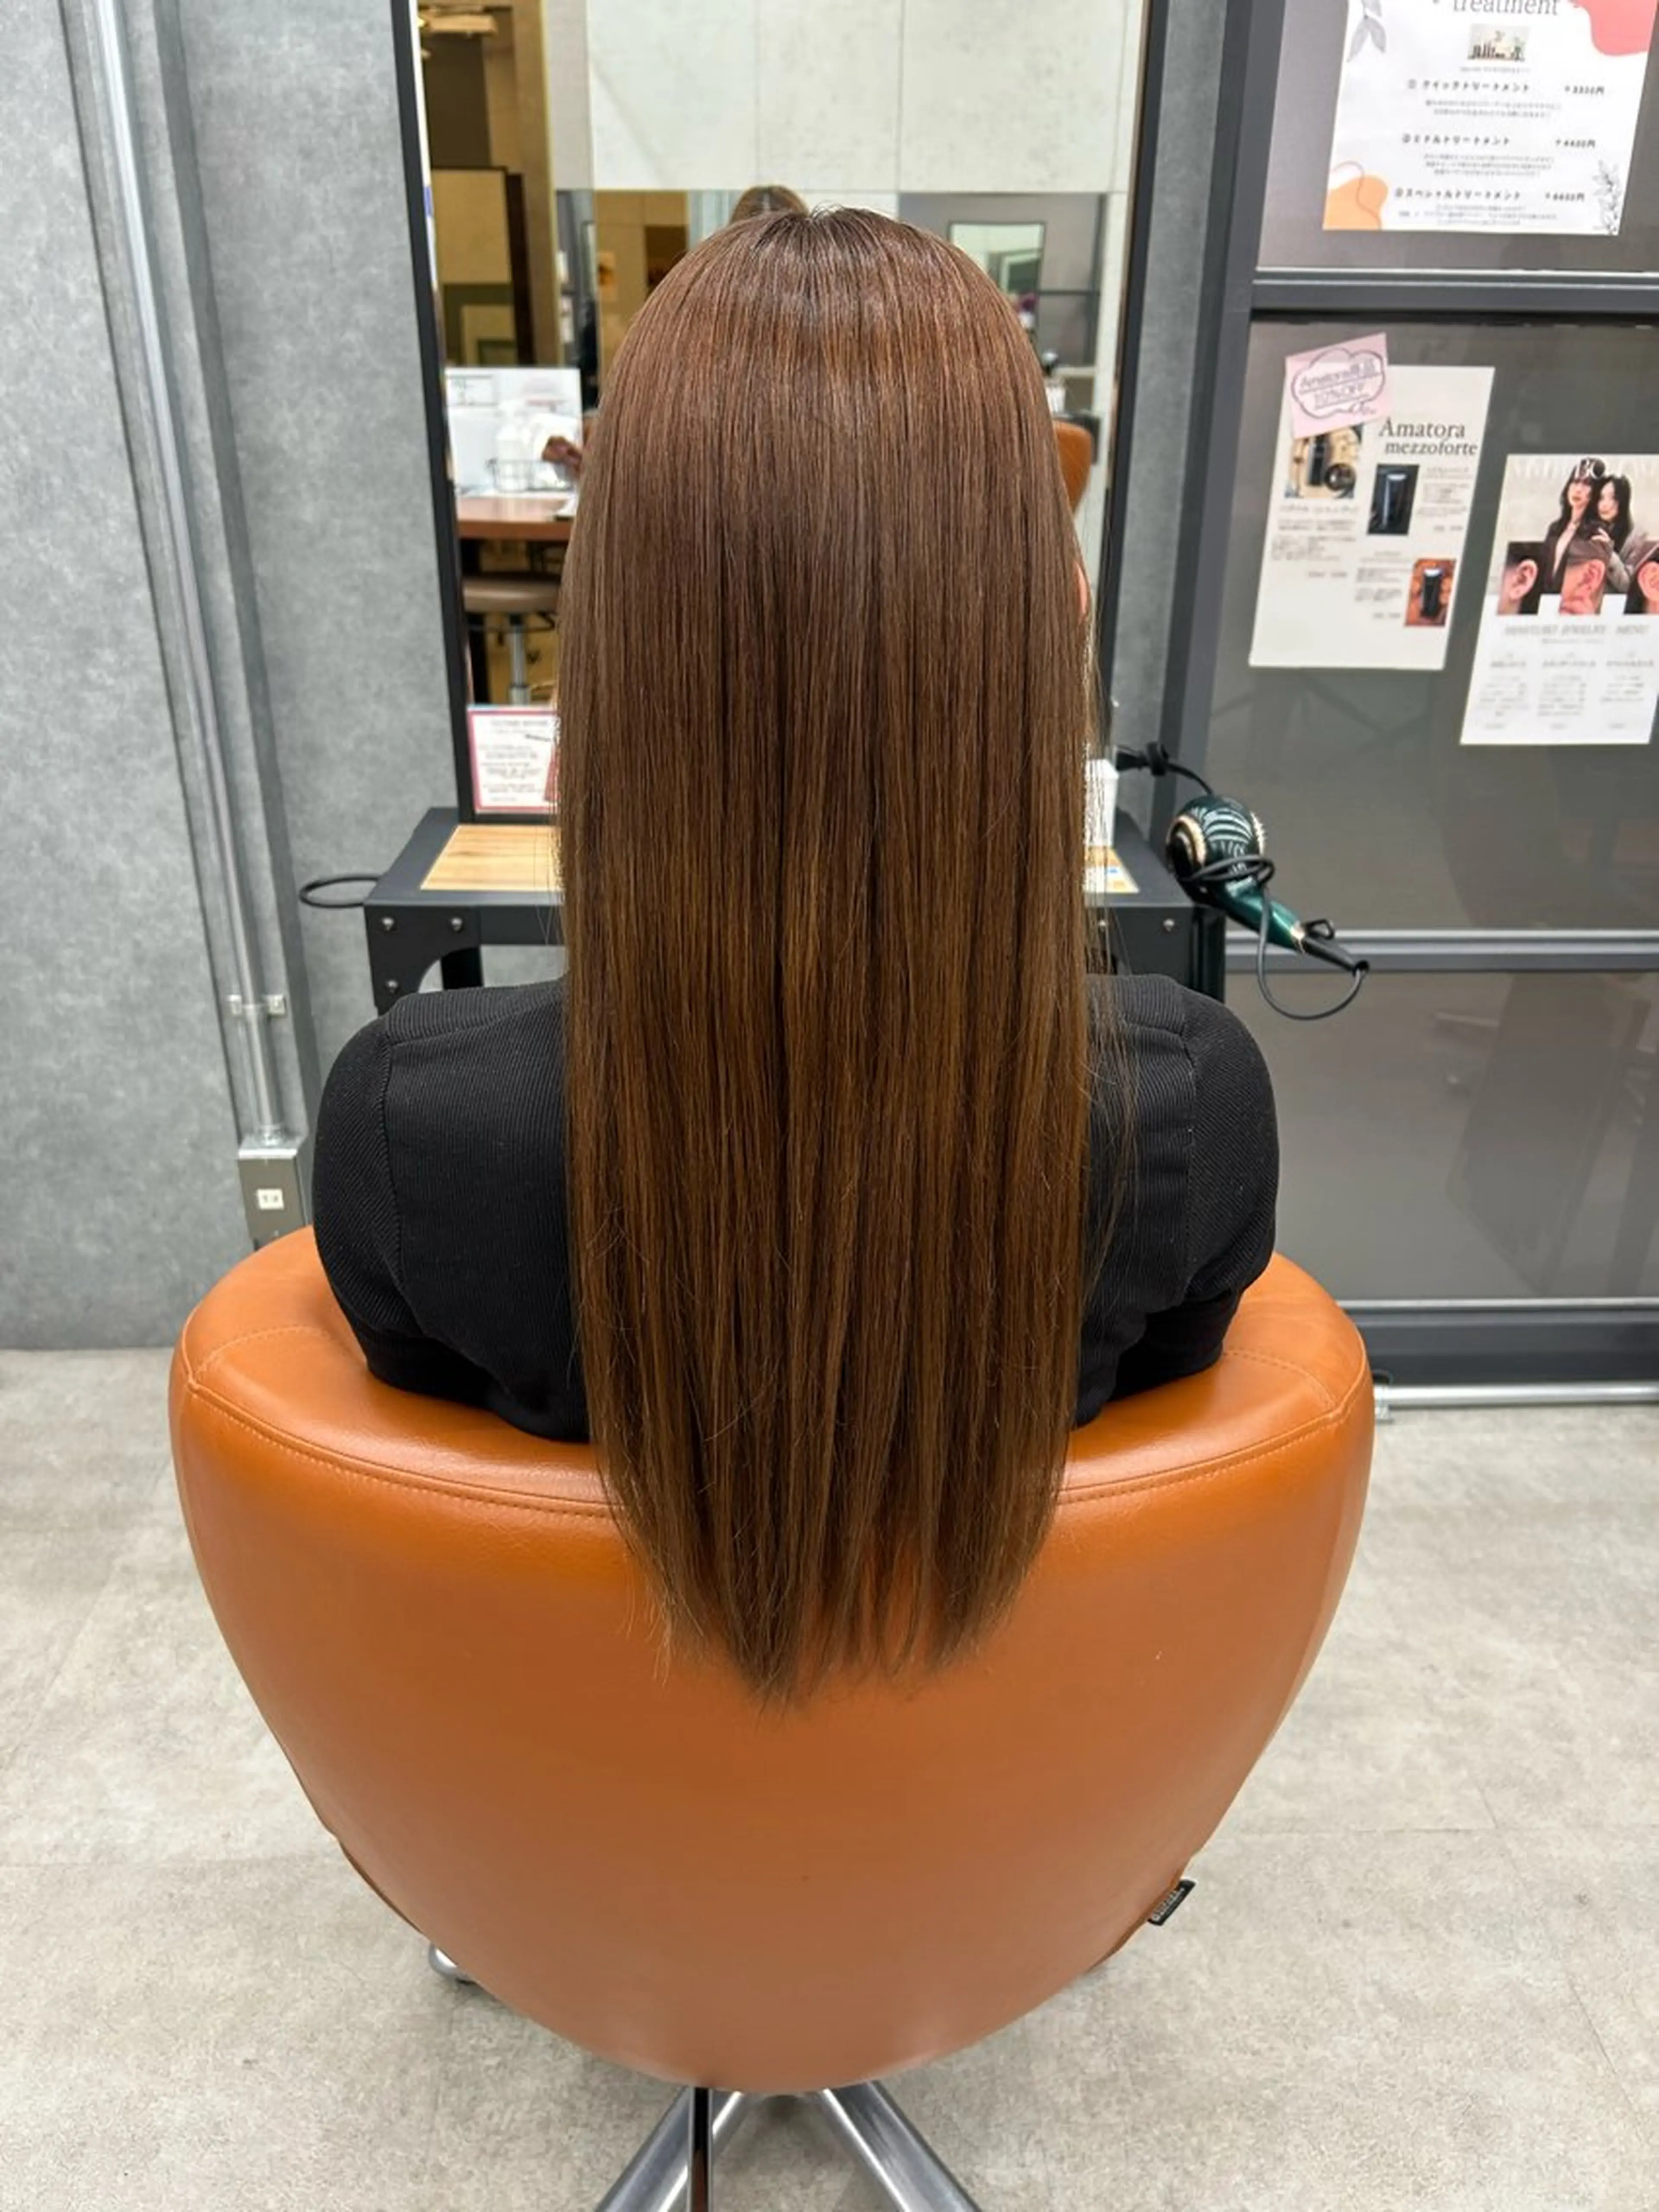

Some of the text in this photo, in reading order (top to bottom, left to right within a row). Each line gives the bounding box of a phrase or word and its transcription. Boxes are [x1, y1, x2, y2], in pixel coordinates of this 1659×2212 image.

[1453, 0, 1558, 16] treatment
[1378, 416, 1465, 438] Amatora
[1385, 437, 1478, 456] mezzoforte
